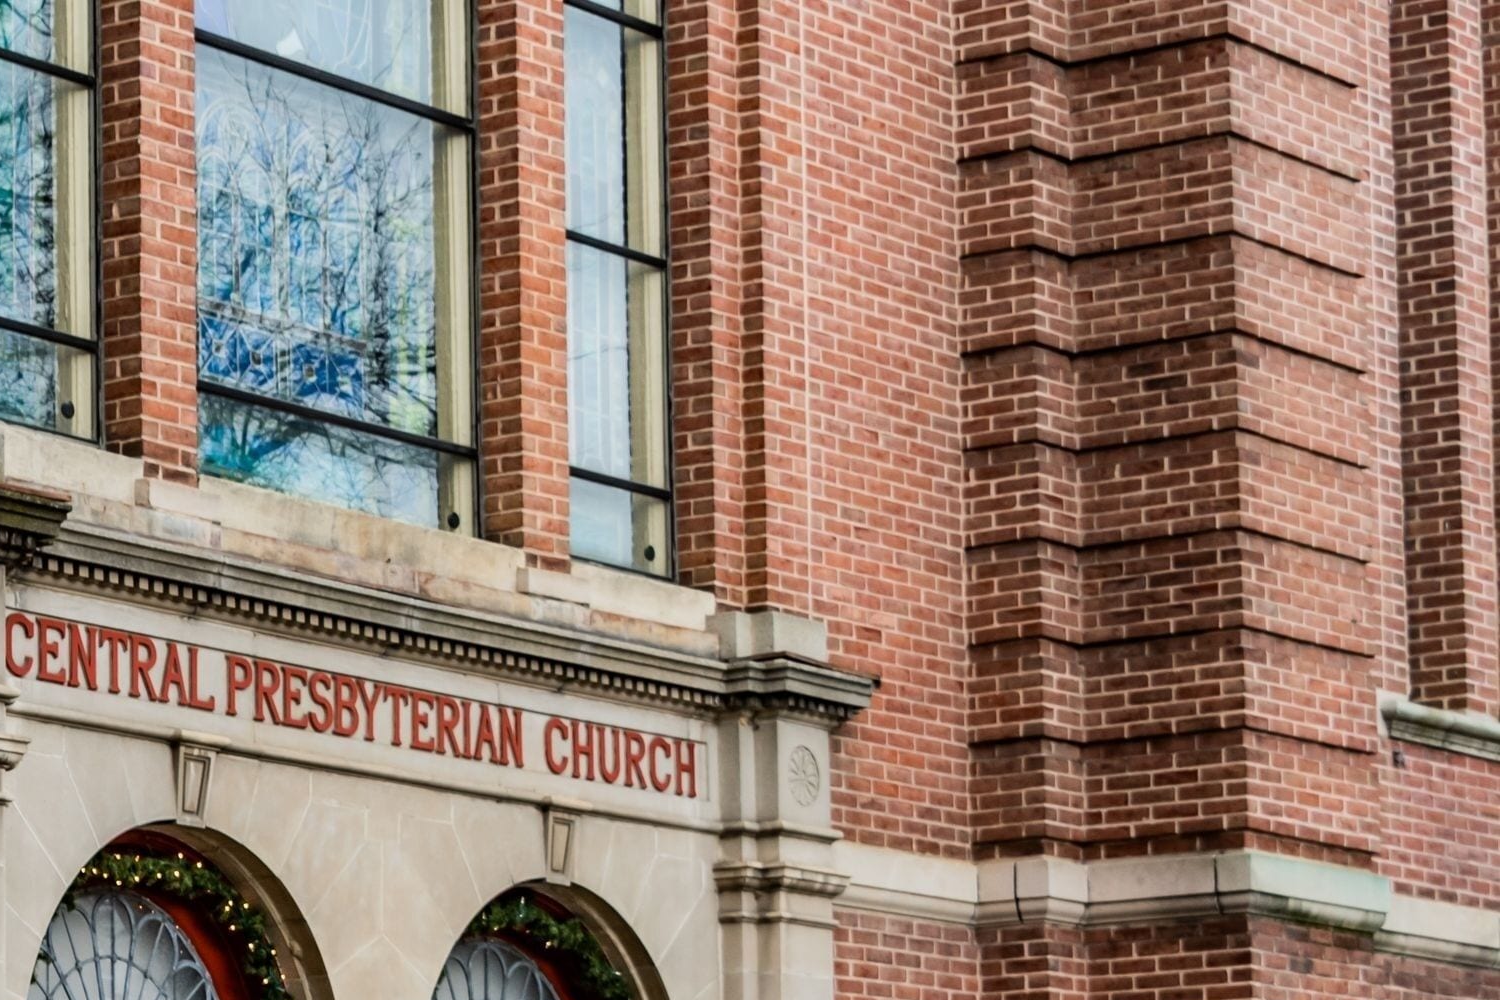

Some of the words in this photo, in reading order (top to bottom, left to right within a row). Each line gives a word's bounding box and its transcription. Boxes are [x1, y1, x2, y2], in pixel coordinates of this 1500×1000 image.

[4, 612, 216, 712] CENTRAL
[224, 653, 524, 769] PRESBYTERIAN
[543, 716, 698, 799] CHURCH
